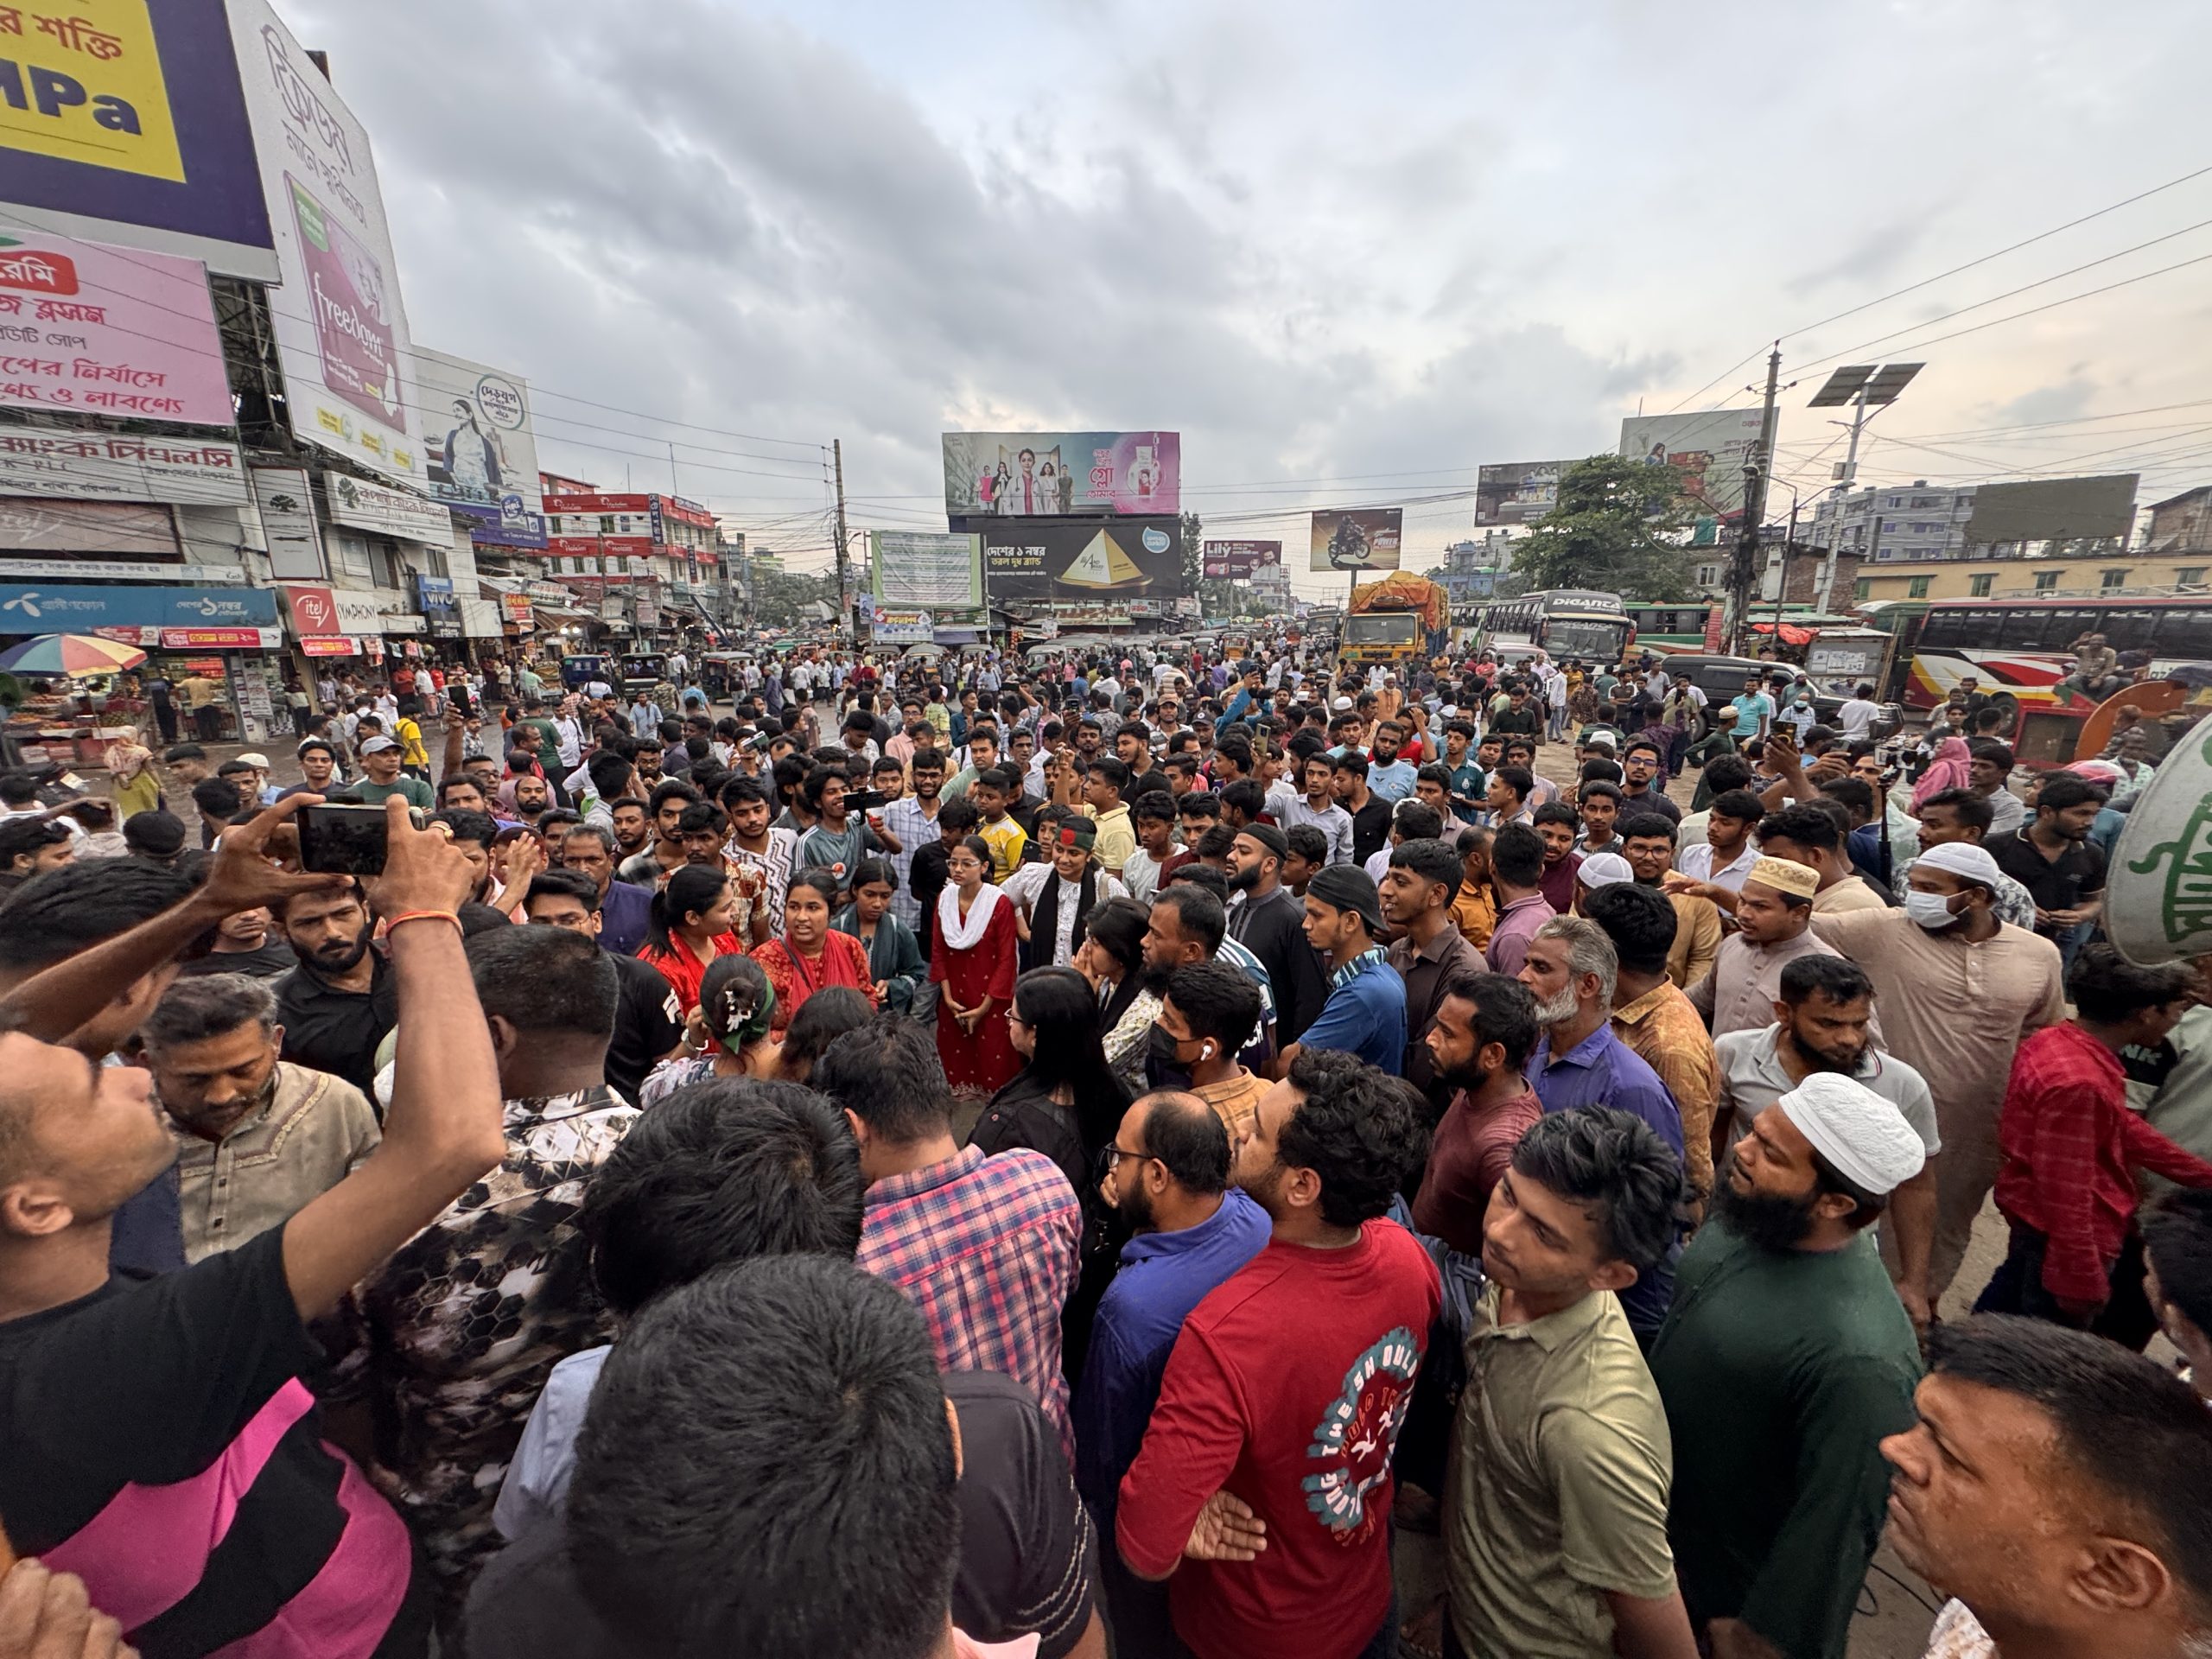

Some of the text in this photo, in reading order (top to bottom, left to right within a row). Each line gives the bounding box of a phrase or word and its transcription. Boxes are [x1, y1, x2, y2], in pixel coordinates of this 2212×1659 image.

[31, 16, 123, 60] শক্তি
[314, 271, 384, 358] freedom
[46, 334, 87, 350] সোপ
[0, 355, 168, 387] পের নির্যাসে
[49, 388, 74, 403] ও
[84, 390, 185, 414] লাবণ্যে
[106, 439, 234, 468] পিএলসি
[1206, 543, 1231, 558] Lily
[305, 600, 323, 616] itel
[336, 602, 377, 621] SYMPHONY
